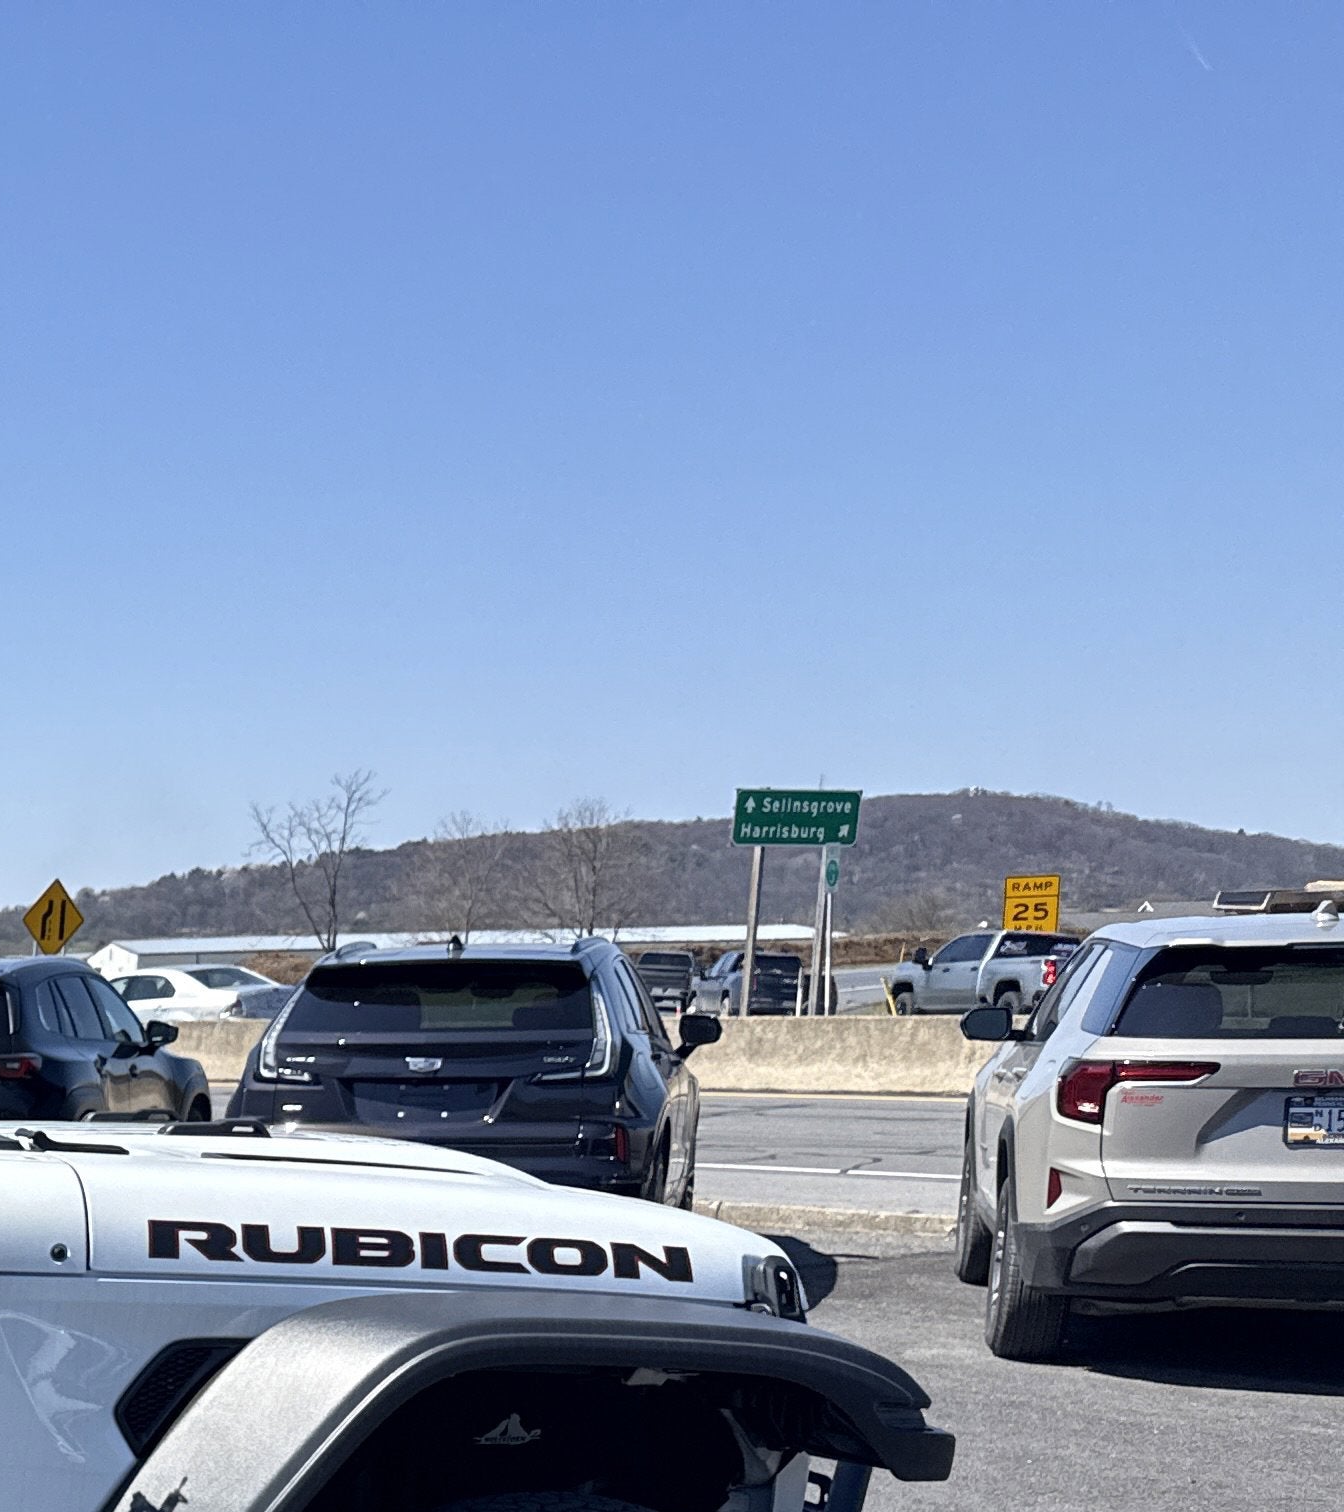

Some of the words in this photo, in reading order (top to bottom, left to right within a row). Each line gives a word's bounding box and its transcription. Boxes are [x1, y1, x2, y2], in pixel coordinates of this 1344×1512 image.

[761, 797, 852, 817] Selinsgrove
[740, 823, 825, 842] Harrisburg
[1012, 881, 1054, 892] RAMP
[1012, 902, 1049, 921] 25
[147, 1219, 694, 1283] RUBICON
